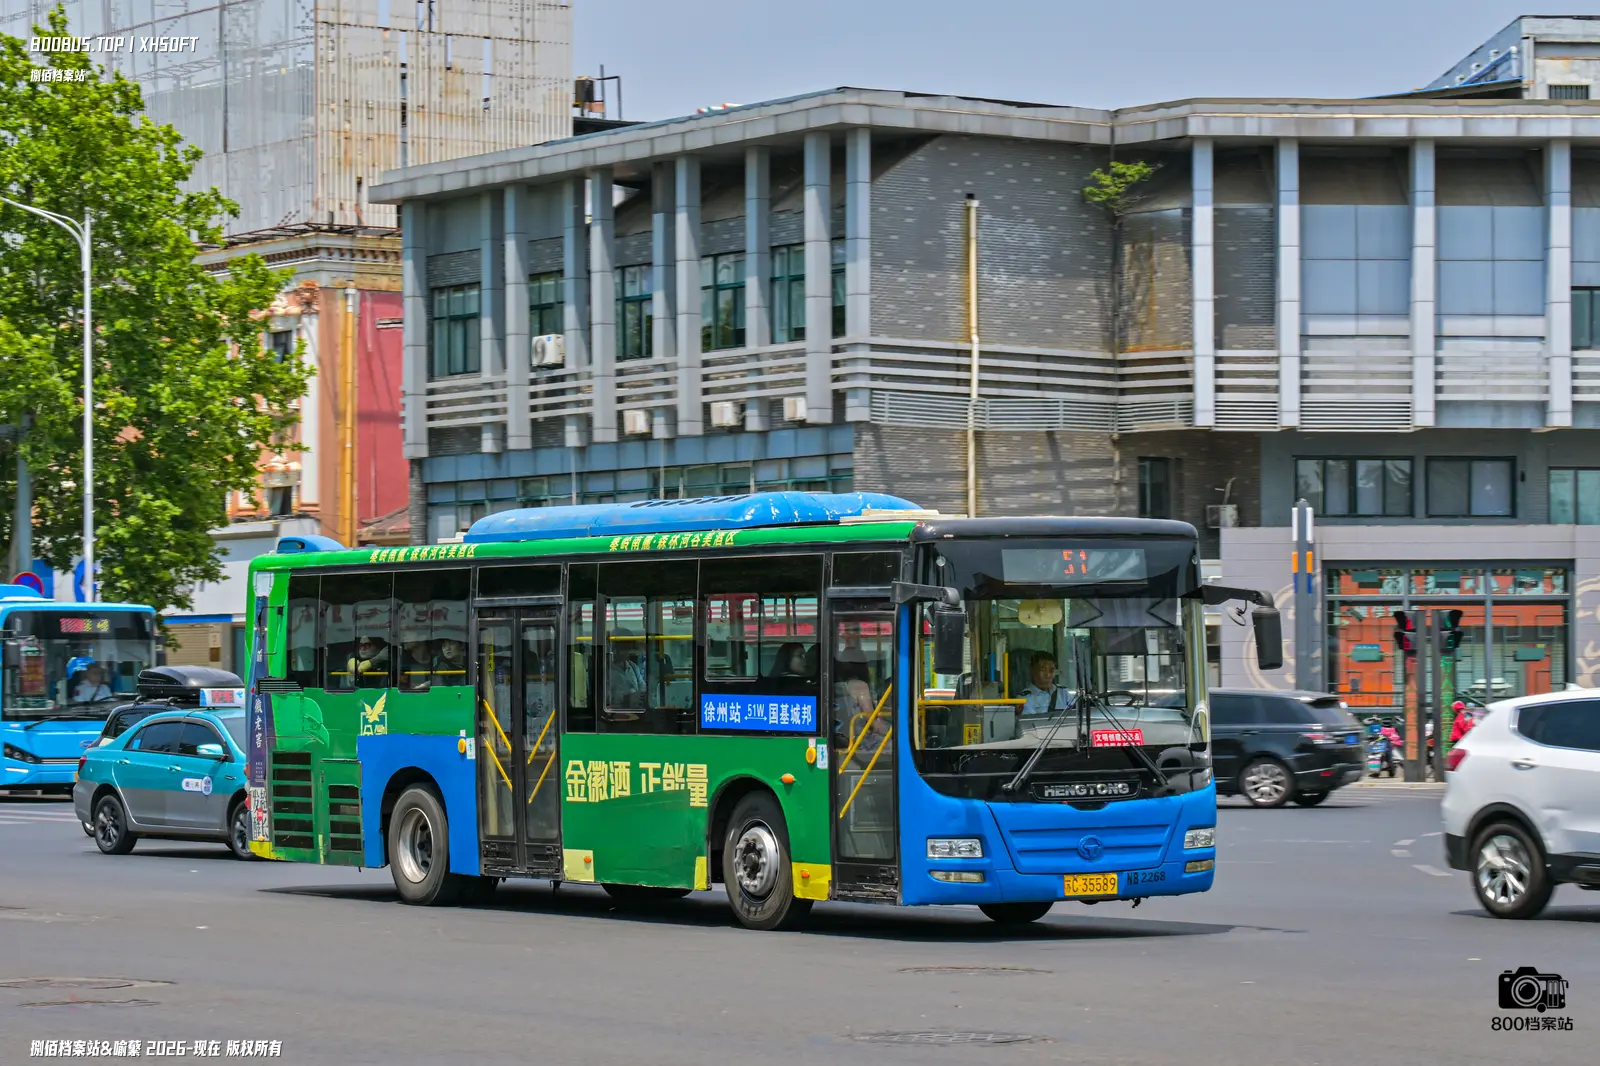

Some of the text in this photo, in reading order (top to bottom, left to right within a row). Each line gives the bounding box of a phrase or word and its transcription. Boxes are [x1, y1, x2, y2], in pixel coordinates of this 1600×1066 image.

[704, 701, 812, 725] 徐州站 51W 国基城邦
[565, 760, 709, 807] 金徽酒 正能量
[1044, 782, 1130, 797] HENGTONG
[1141, 871, 1166, 883] 2268
